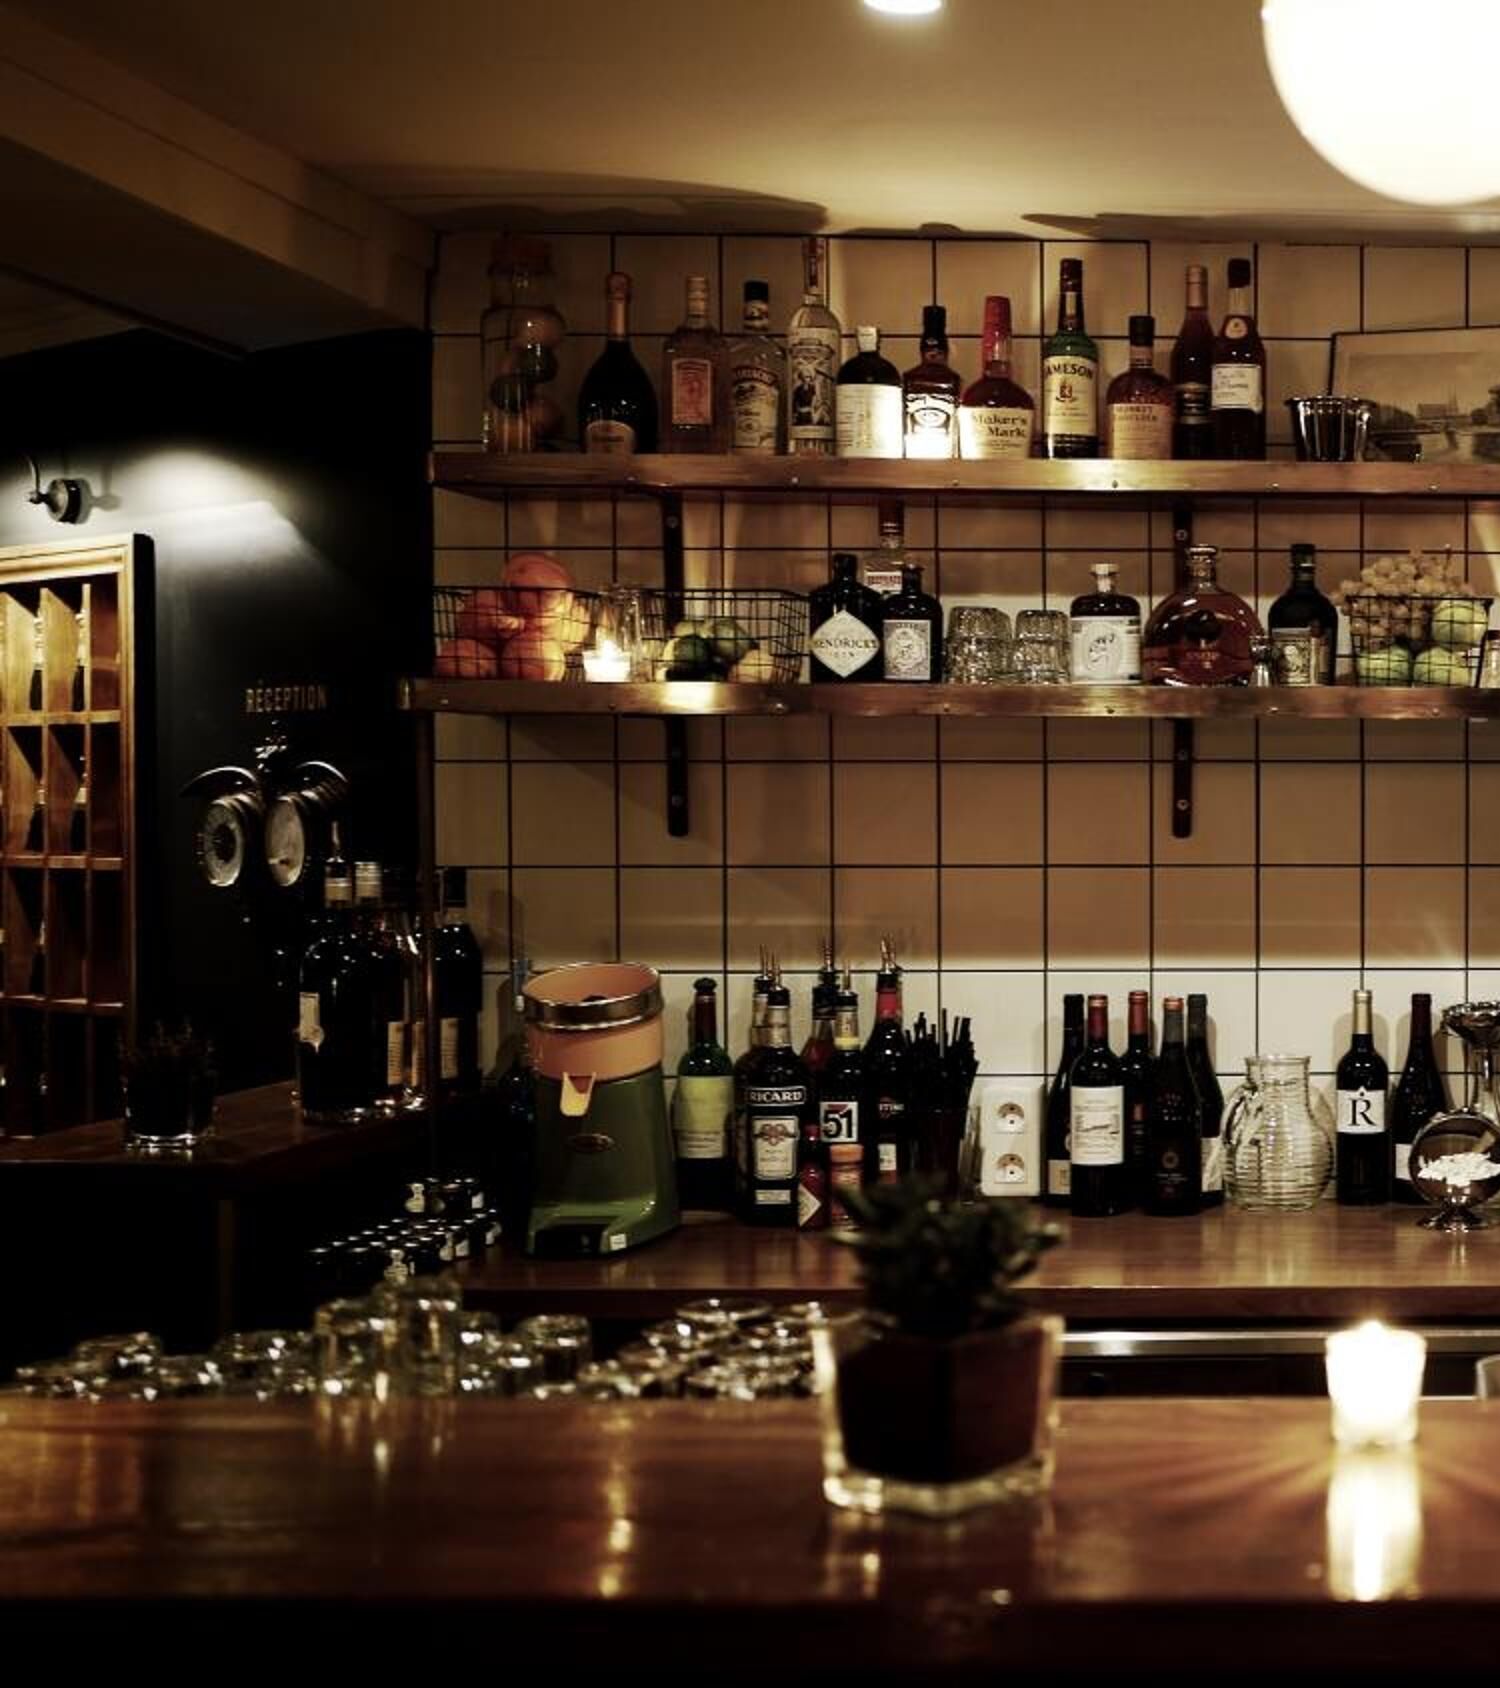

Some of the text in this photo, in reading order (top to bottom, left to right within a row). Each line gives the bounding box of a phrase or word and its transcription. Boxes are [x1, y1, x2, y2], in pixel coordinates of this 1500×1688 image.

[988, 427, 1026, 438] Mark
[814, 639, 877, 648] HENDRICKS
[750, 1091, 803, 1103] RICARD
[1347, 1097, 1377, 1127] R
[822, 1109, 853, 1138] 51
